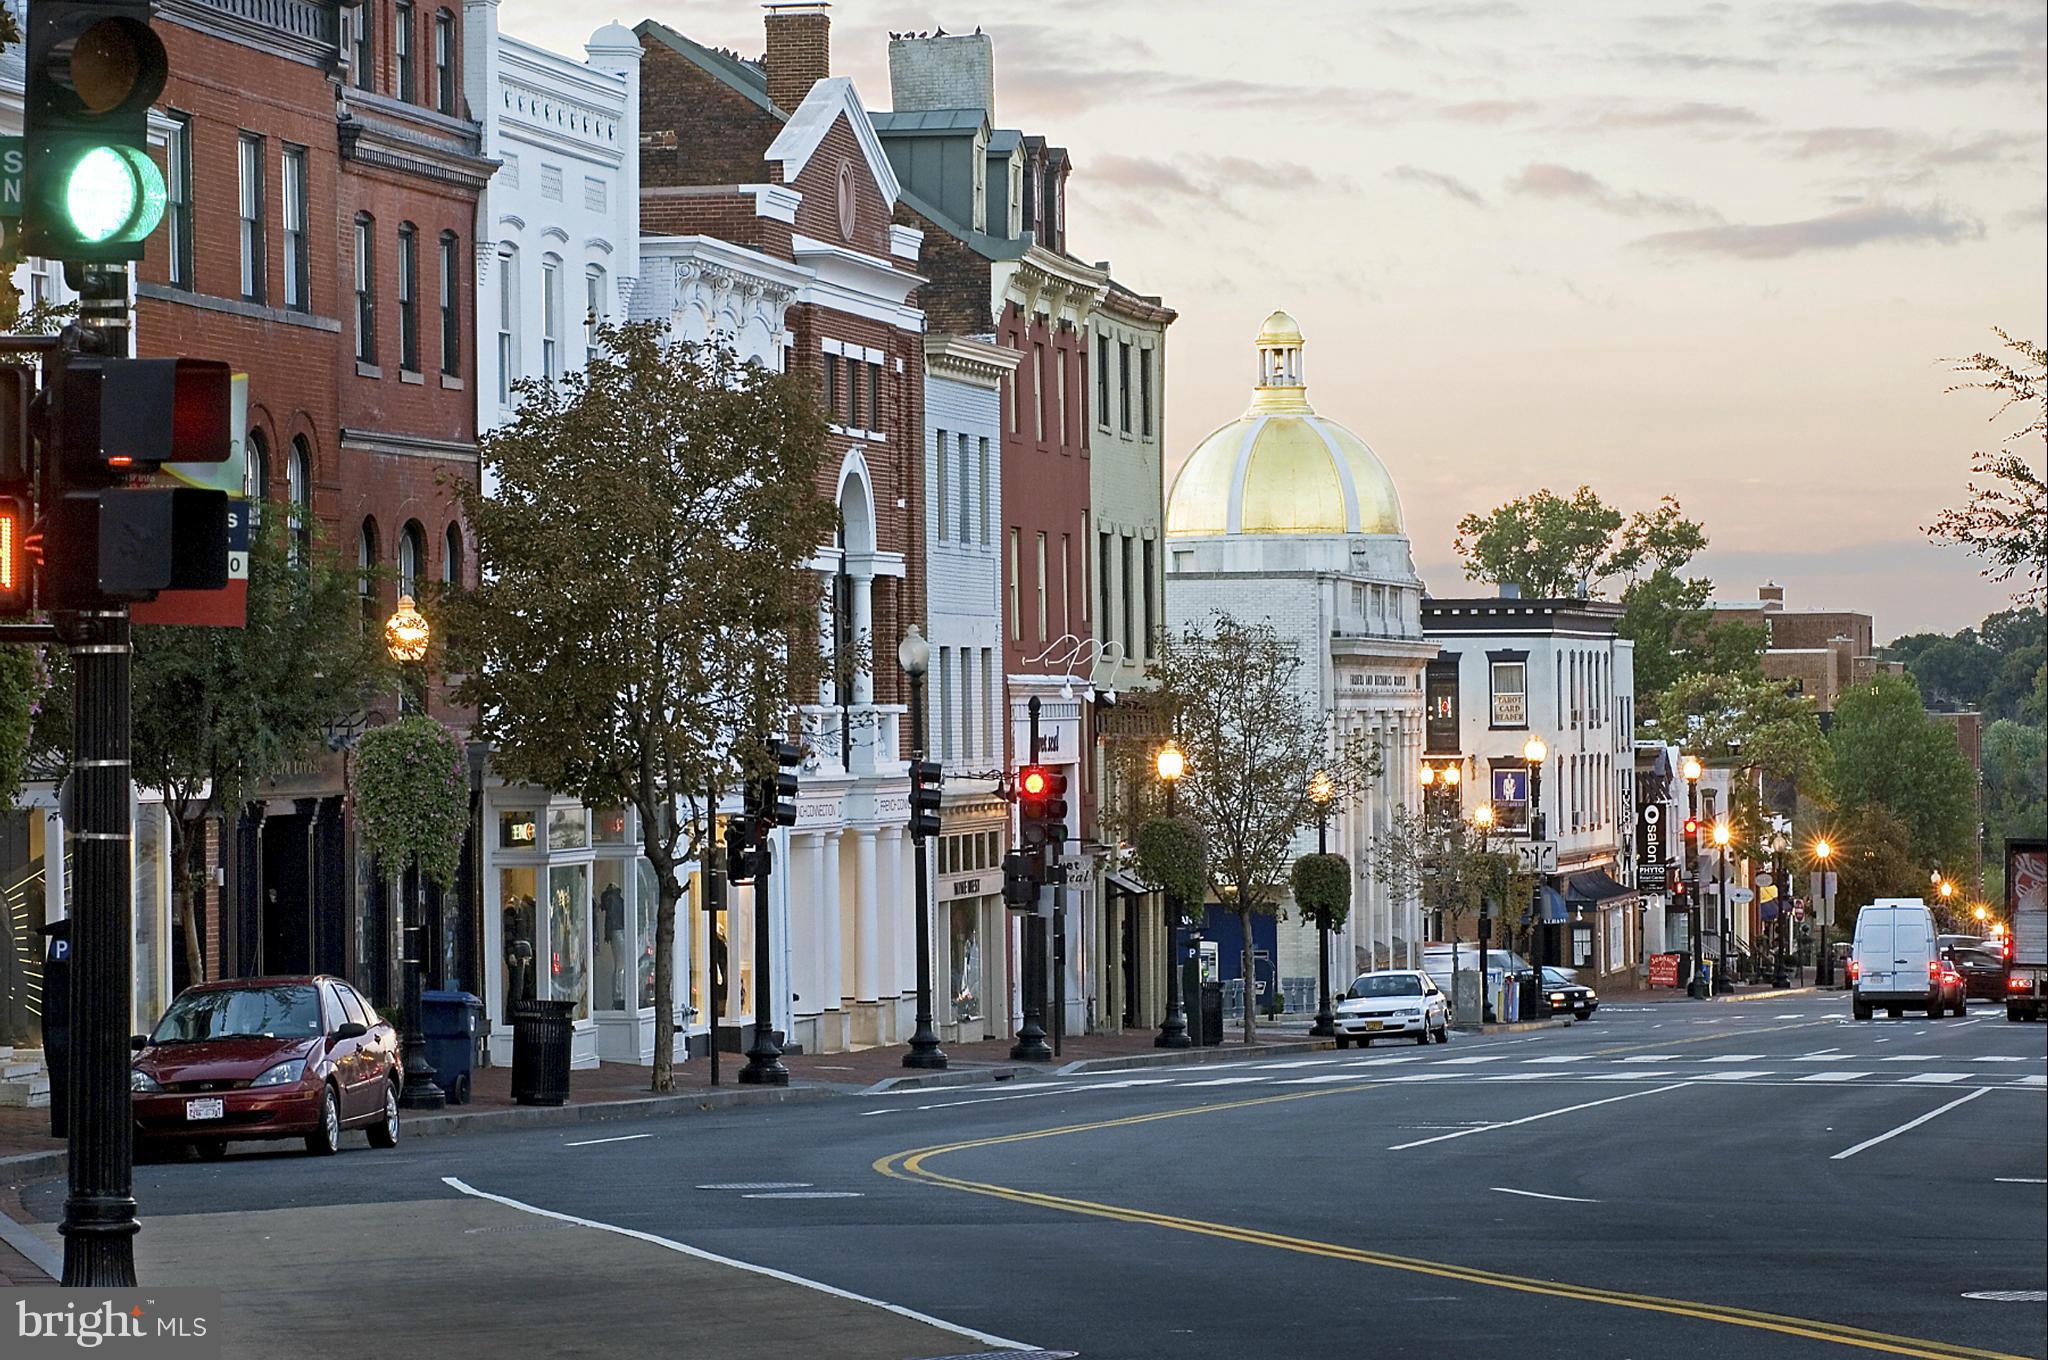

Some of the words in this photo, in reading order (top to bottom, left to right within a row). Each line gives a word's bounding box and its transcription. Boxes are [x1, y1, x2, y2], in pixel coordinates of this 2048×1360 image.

[1497, 696, 1522, 704] TAROT
[1499, 705, 1520, 713] CARD
[1496, 713, 1524, 721] READER
[56, 940, 68, 959] P
[1189, 948, 1196, 958] P
